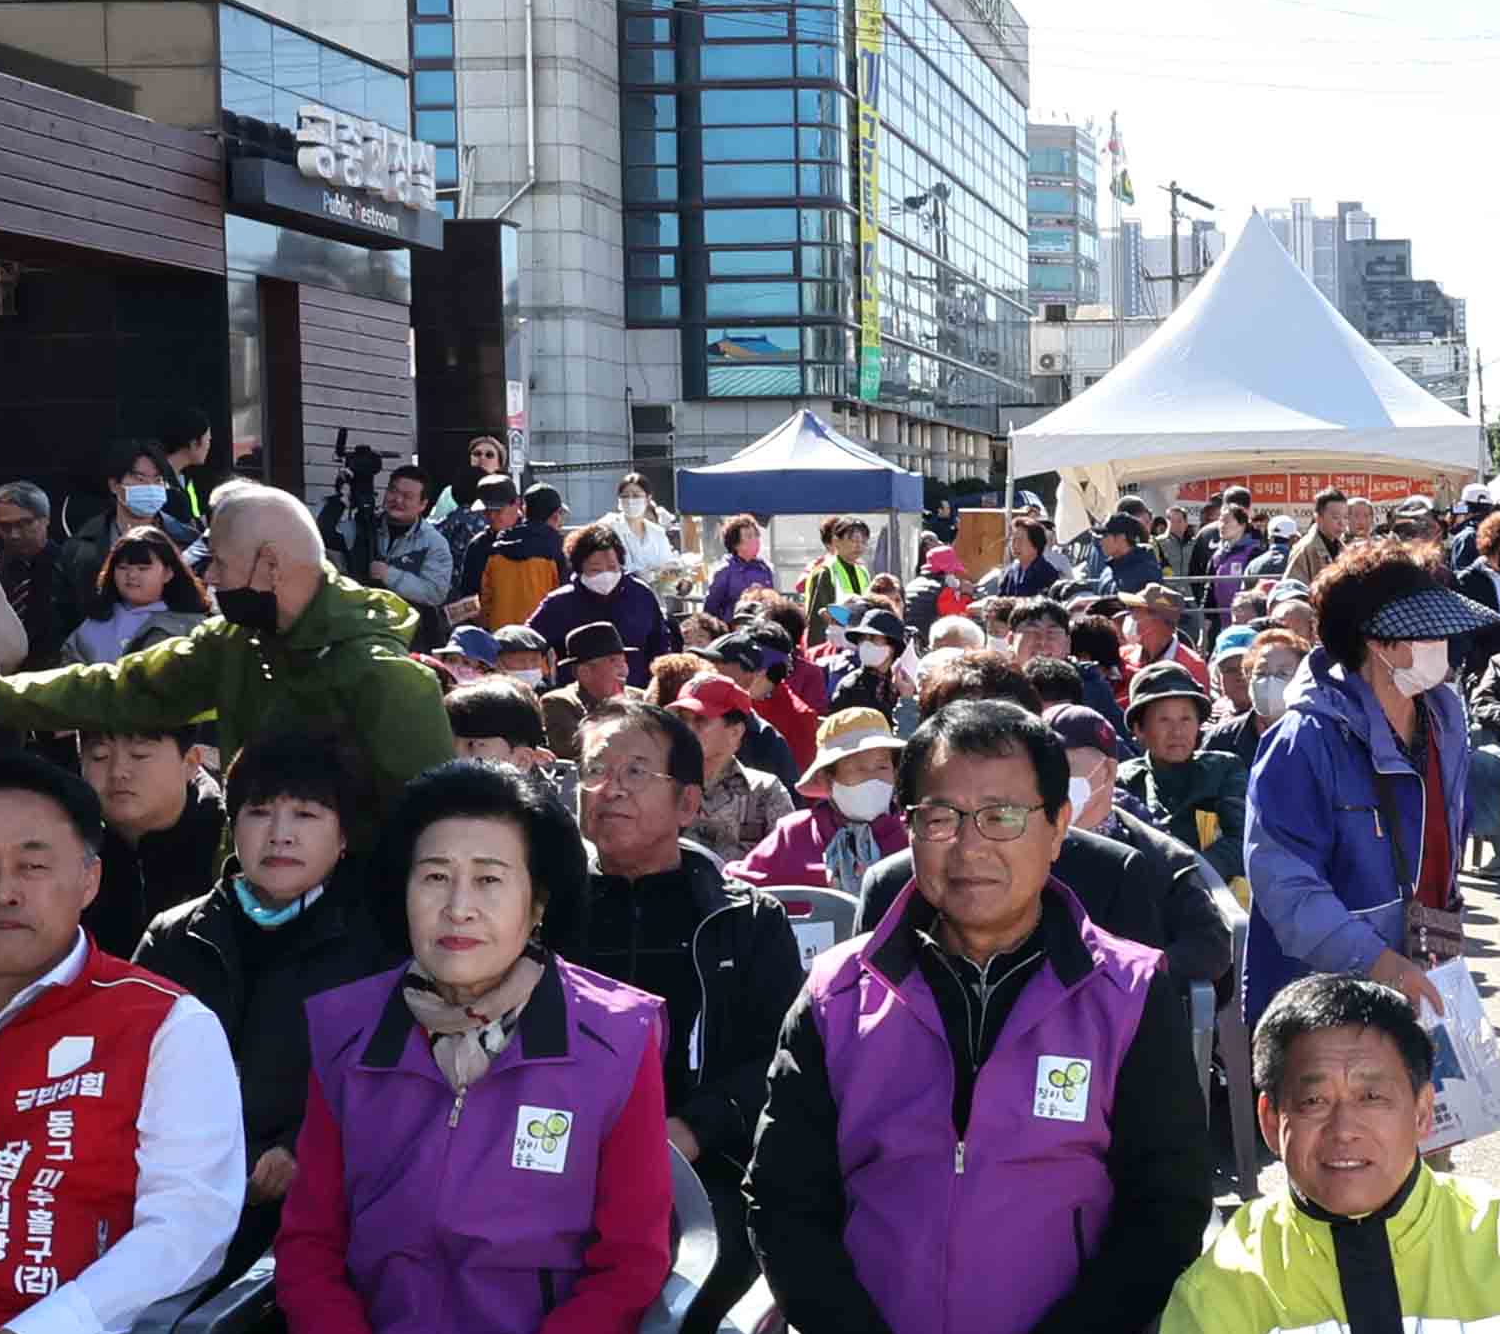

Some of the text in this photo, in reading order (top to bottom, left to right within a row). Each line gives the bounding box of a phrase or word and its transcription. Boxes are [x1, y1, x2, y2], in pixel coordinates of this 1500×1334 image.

[322, 189, 398, 233] Public Restroom
[45, 1109, 75, 1162] 동구
